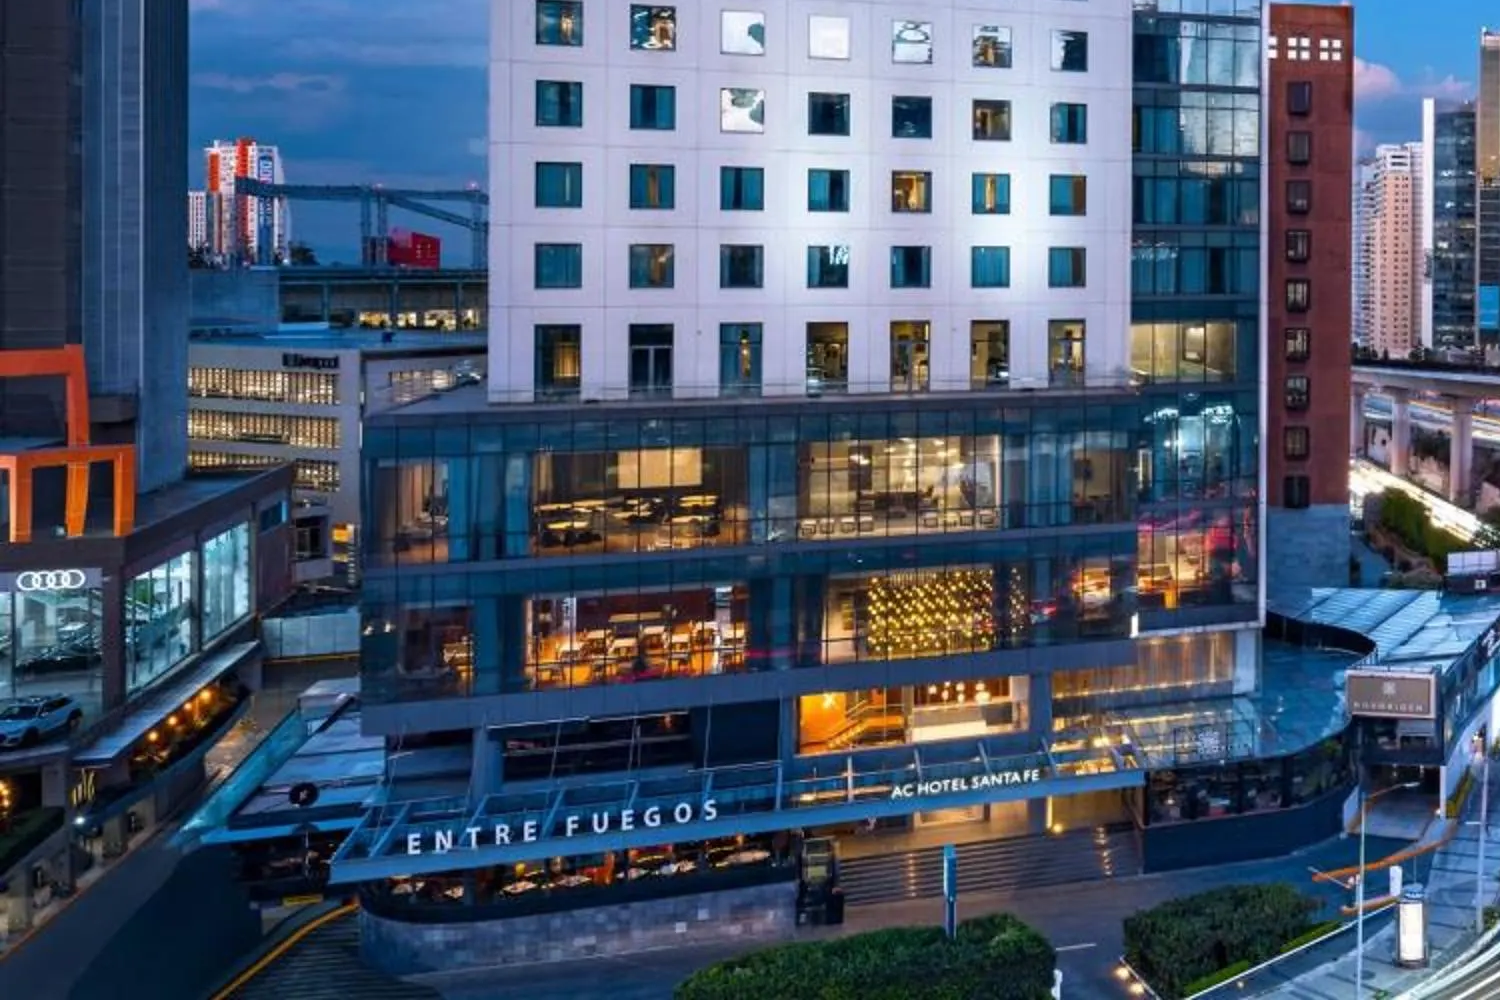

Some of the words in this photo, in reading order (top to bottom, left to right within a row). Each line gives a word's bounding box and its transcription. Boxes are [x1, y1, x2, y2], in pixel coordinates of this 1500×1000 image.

[891, 784, 914, 799] AC
[916, 778, 968, 795] HOTEL
[971, 771, 1020, 789] SANTA
[1023, 769, 1040, 781] FE
[407, 820, 538, 855] ENTRE
[566, 799, 718, 837] FUEGOS
